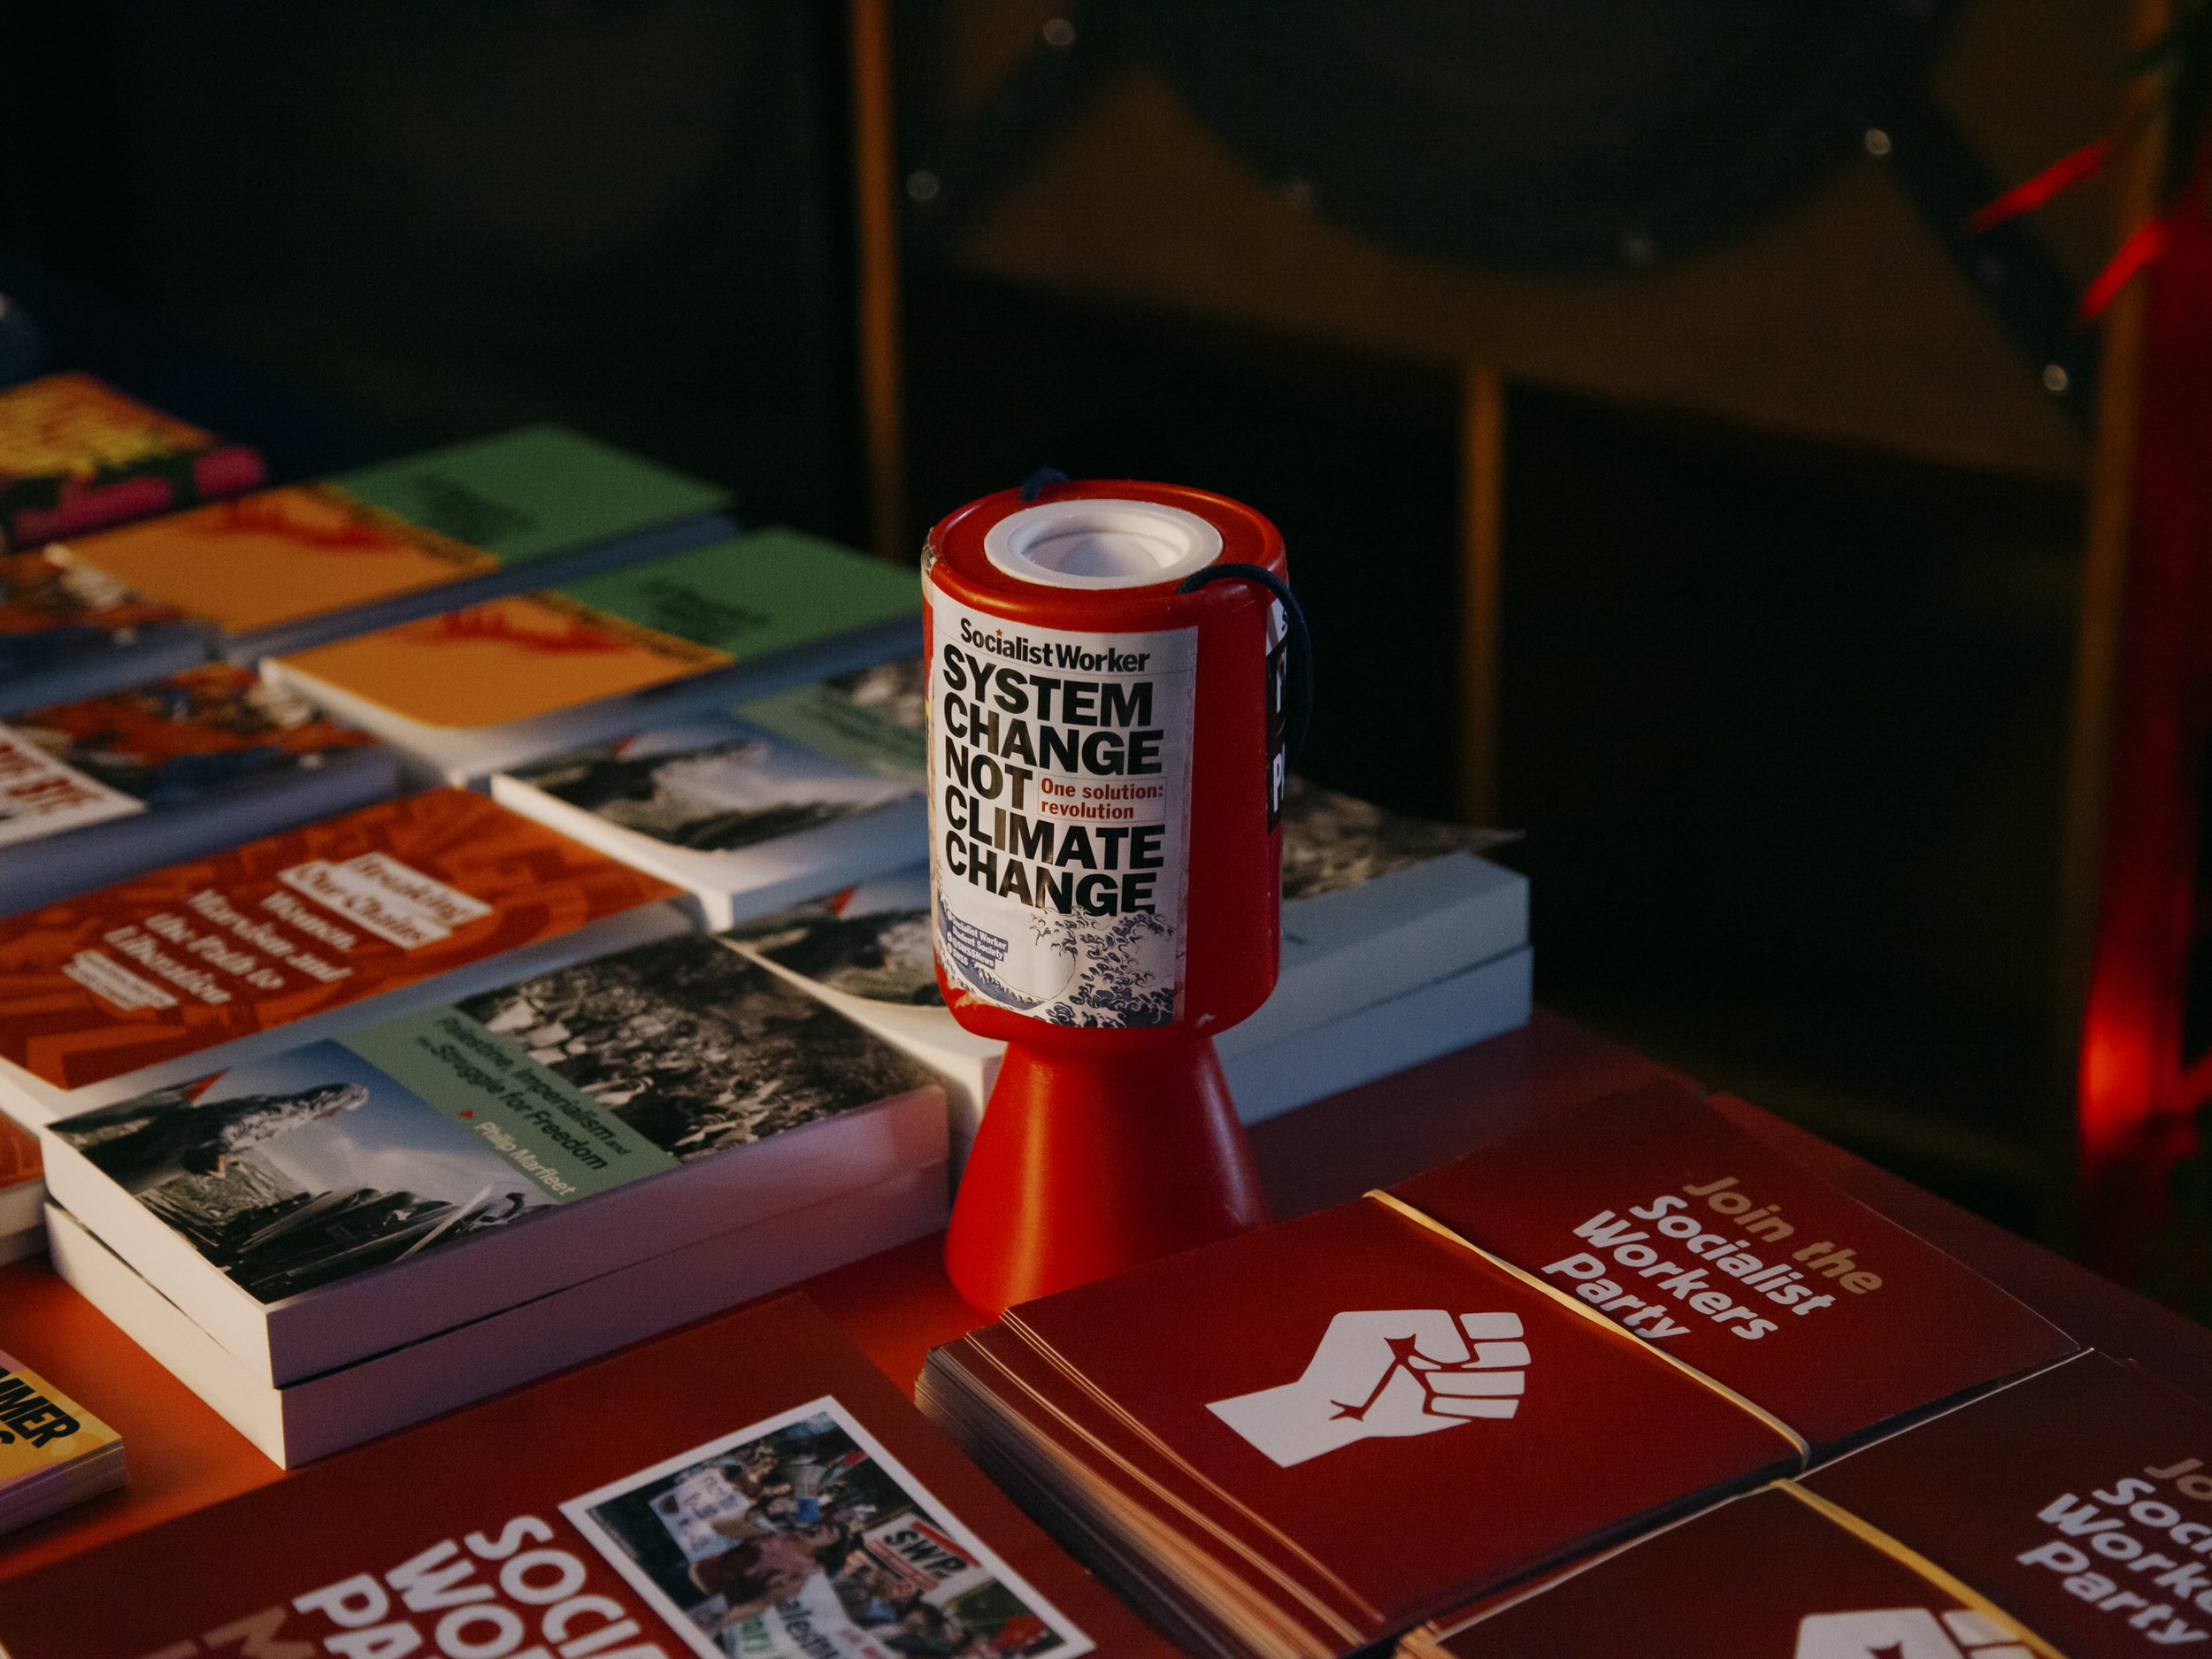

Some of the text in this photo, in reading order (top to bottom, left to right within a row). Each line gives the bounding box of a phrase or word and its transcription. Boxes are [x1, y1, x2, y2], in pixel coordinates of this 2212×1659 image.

[942, 643, 1154, 728] SYSTEM
[961, 618, 1150, 672] Socialist Worker
[943, 692, 1164, 776] CHANGE
[945, 735, 1033, 810] NOT
[945, 785, 1165, 871] CLIMATE
[1041, 777, 1164, 801] One solution:
[1041, 799, 1134, 819] revolution
[945, 830, 1157, 917] CHANGE
[977, 941, 1003, 961] Society
[979, 931, 1007, 949] Worker
[501, 1091, 532, 1112] for
[524, 1109, 607, 1171] Freedom
[512, 1069, 615, 1141] Imperialism
[605, 1139, 632, 1156] and
[474, 1120, 576, 1196] Philip Marfleet
[1572, 1210, 1779, 1341] Workers
[1629, 1195, 1837, 1317] Socialist
[1683, 1176, 1884, 1295] Join the
[1541, 1252, 1692, 1340] Party
[385, 1538, 556, 1659] WO
[2015, 1540, 2210, 1646] Party
